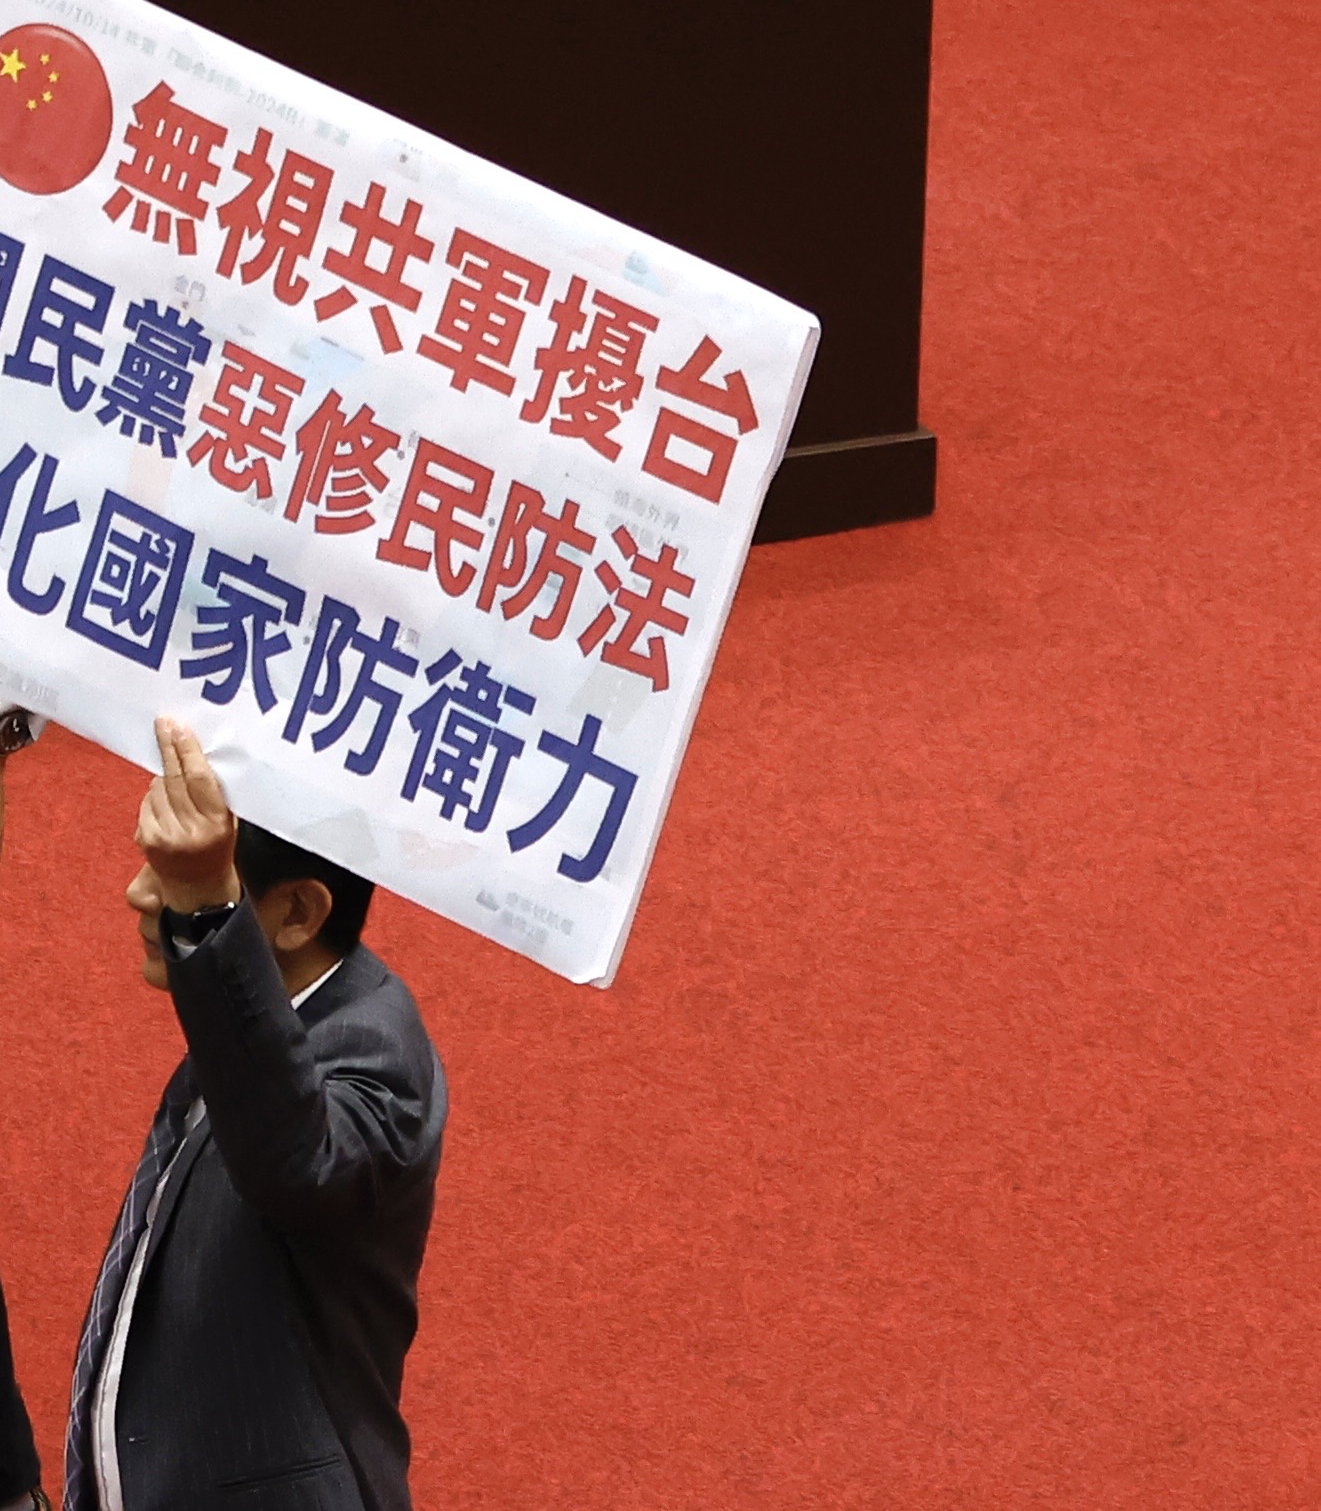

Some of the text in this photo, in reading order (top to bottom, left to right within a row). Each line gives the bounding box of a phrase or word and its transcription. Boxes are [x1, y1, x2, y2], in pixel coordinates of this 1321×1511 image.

[103, 82, 759, 505] 無視共軍擾台
